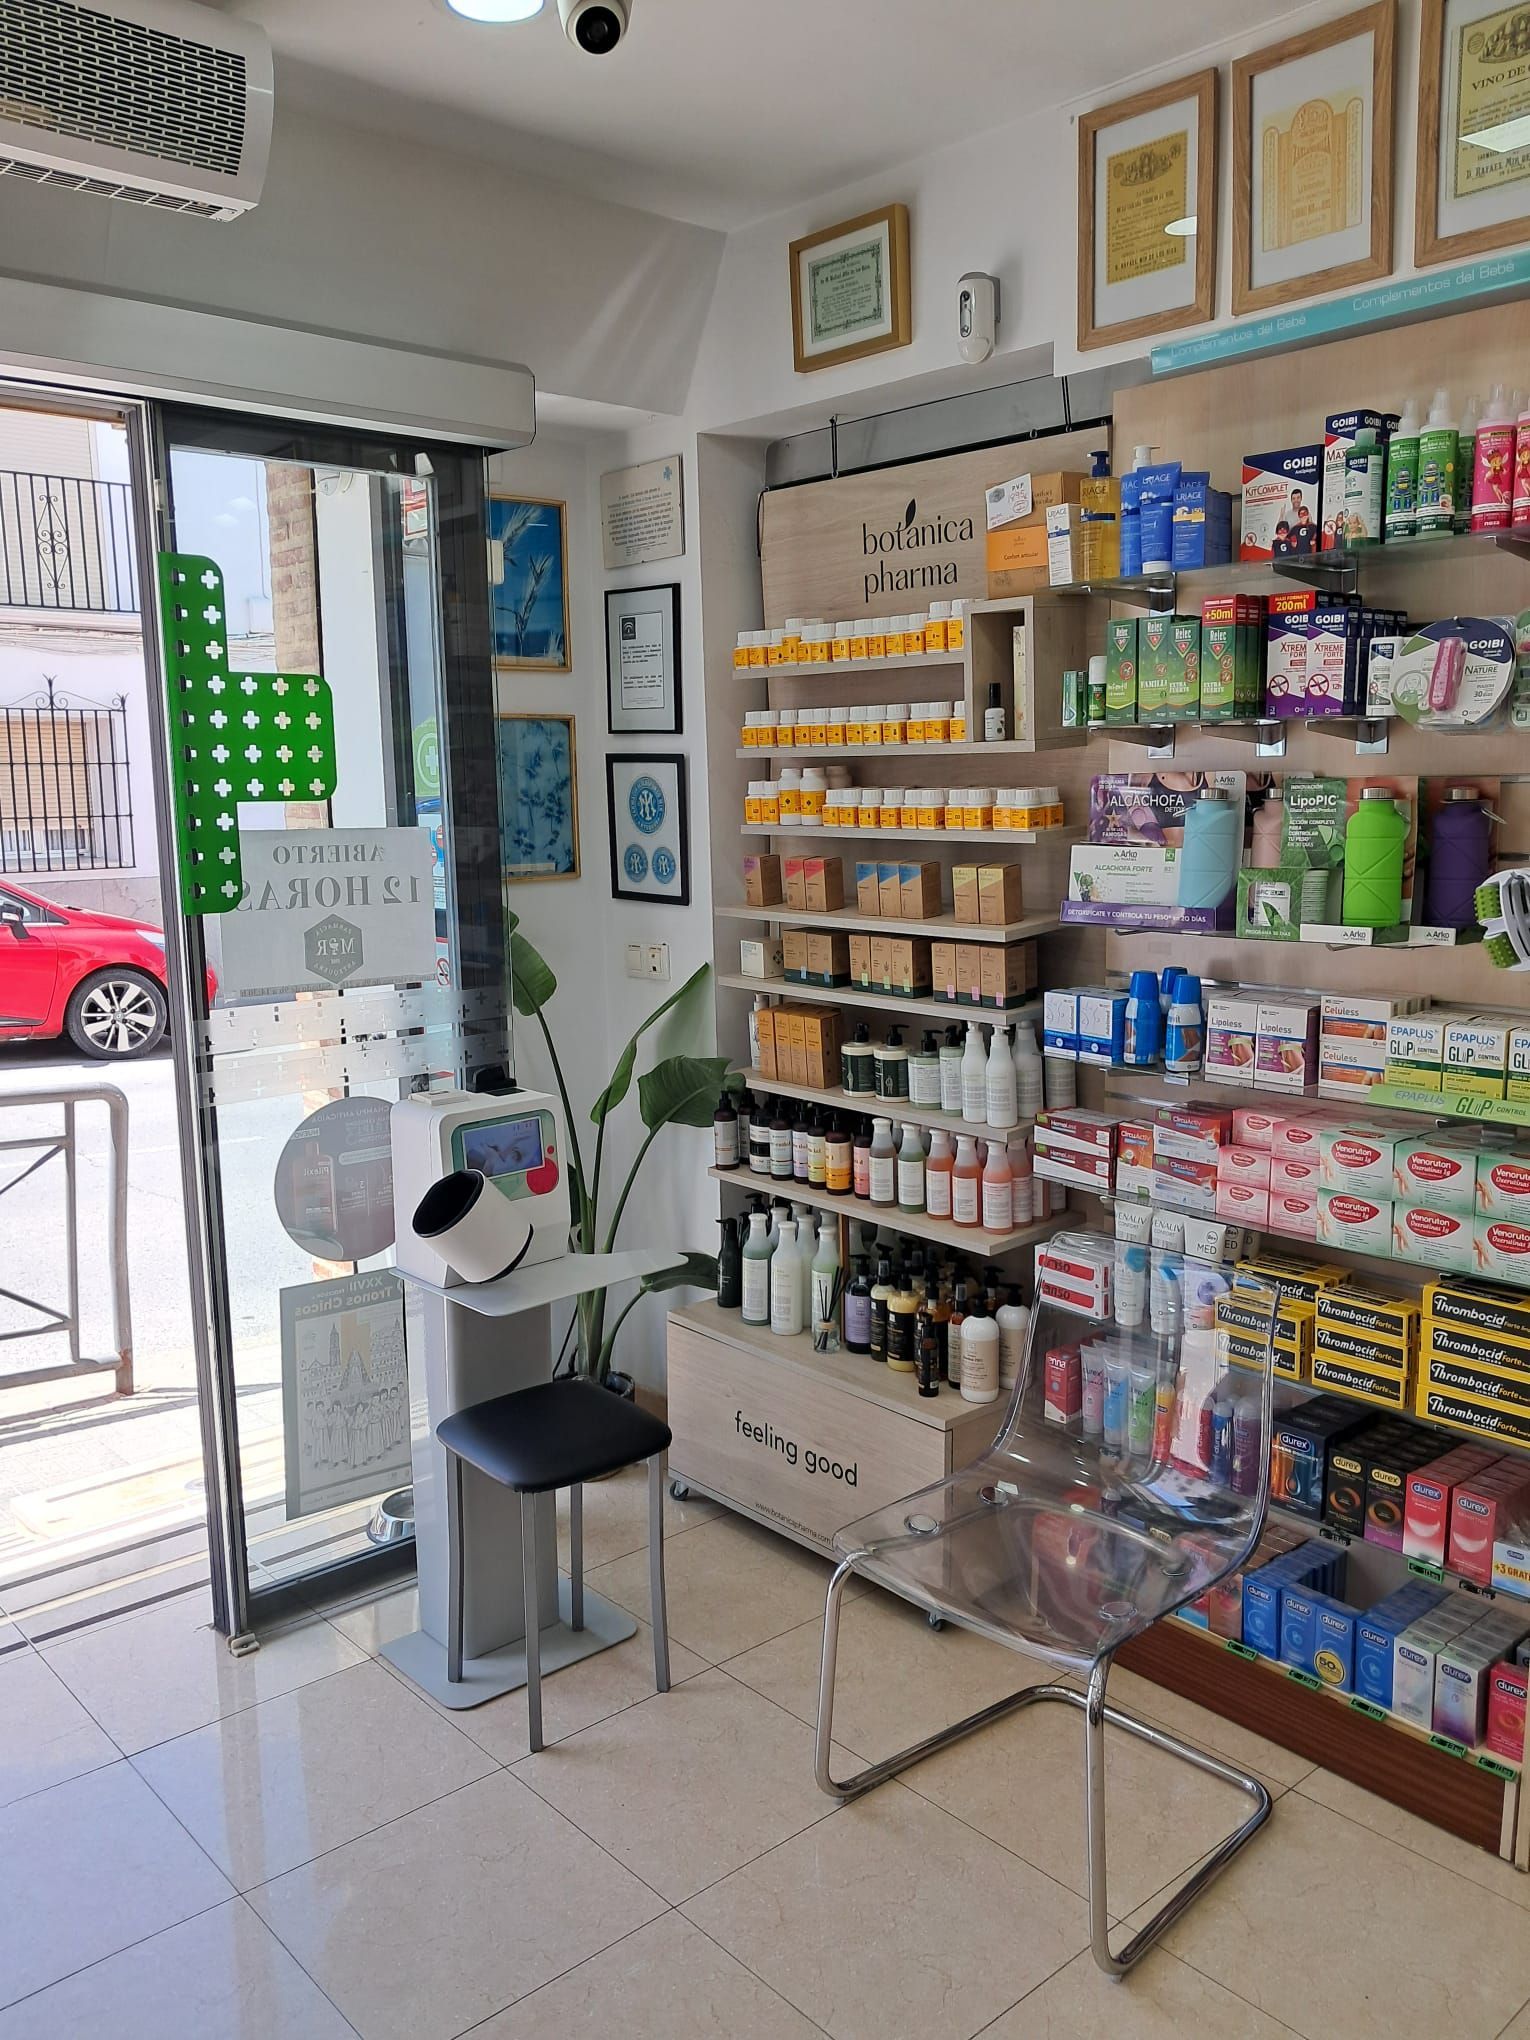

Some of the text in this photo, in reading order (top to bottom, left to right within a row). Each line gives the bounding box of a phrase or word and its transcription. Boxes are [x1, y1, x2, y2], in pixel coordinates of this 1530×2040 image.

[1472, 67, 1525, 91] VINO DE
[1475, 161, 1502, 178] RAFAEL
[1353, 263, 1514, 311] Complementos del Bebé
[1170, 315, 1306, 358] Complementos del Bebé
[1331, 416, 1358, 428] GOIBI
[1364, 416, 1381, 427] GOIBI
[1283, 456, 1317, 470] GOIBI
[1349, 457, 1367, 466] GOIBI
[864, 560, 958, 603] pharma
[1275, 601, 1306, 612] 200ml
[1205, 608, 1233, 621] +50ml
[1284, 614, 1308, 624] GOIB
[1315, 614, 1344, 624] GOIBI
[1147, 621, 1163, 633] Relec
[1175, 628, 1191, 639] Relec
[1209, 630, 1227, 641] Relec
[1314, 642, 1343, 654] XTREME
[1469, 639, 1504, 649] GOIBI
[1464, 665, 1498, 675] NATURE
[1110, 794, 1185, 808] ALCACHOFA
[1290, 795, 1337, 807] LipoPIC
[1120, 849, 1138, 858] Arko
[1191, 914, 1206, 924] DÍAS
[1324, 1005, 1359, 1017] Celuless
[1211, 1018, 1242, 1029] Lipoless
[1260, 1023, 1292, 1035] Lipoless
[1391, 1025, 1434, 1040] EPAPLUS
[1449, 1031, 1495, 1046] EPAPLUS
[1323, 1051, 1358, 1063] Celuless
[1478, 1053, 1501, 1062] CONTROL
[1395, 1090, 1444, 1106] EPAPLUS
[1496, 1106, 1527, 1116] CONTROL
[1173, 1115, 1202, 1127] CircuActiv
[1121, 1130, 1150, 1141] CircuActiv
[1335, 1142, 1372, 1157] Venoruton
[1170, 1161, 1199, 1172] CircuActiv
[1411, 1155, 1451, 1169] Venoruton
[1332, 1198, 1369, 1213] Venoruton
[1410, 1211, 1449, 1226] Venoruton
[1197, 1243, 1217, 1255] MED
[1225, 1239, 1237, 1249] ED
[1317, 1299, 1376, 1325] Thrombocid
[1434, 1295, 1521, 1329] Thrombocid Forte
[1317, 1329, 1391, 1361] Thrombocid Forte
[1433, 1330, 1521, 1365] Thrombocid Forte
[1315, 1361, 1372, 1387] Thrombocid
[1431, 1363, 1518, 1398] Thrombocid Forte
[1429, 1395, 1517, 1433] Thrombocid Forte
[735, 1411, 857, 1487] feeling good
[1282, 1435, 1308, 1450] durex
[1334, 1458, 1360, 1472] durex
[1374, 1471, 1400, 1485] durex
[1414, 1484, 1440, 1499] durex
[1459, 1498, 1487, 1514] durex
[1494, 1563, 1506, 1574] +3
[1249, 1586, 1270, 1600] durex
[1287, 1599, 1310, 1614] durex
[1321, 1615, 1347, 1631] durex
[1362, 1629, 1387, 1645] durex
[1400, 1647, 1426, 1663] durex
[1320, 1657, 1335, 1669] 50
[1443, 1665, 1470, 1681] durex
[1497, 1680, 1527, 1697] durex
